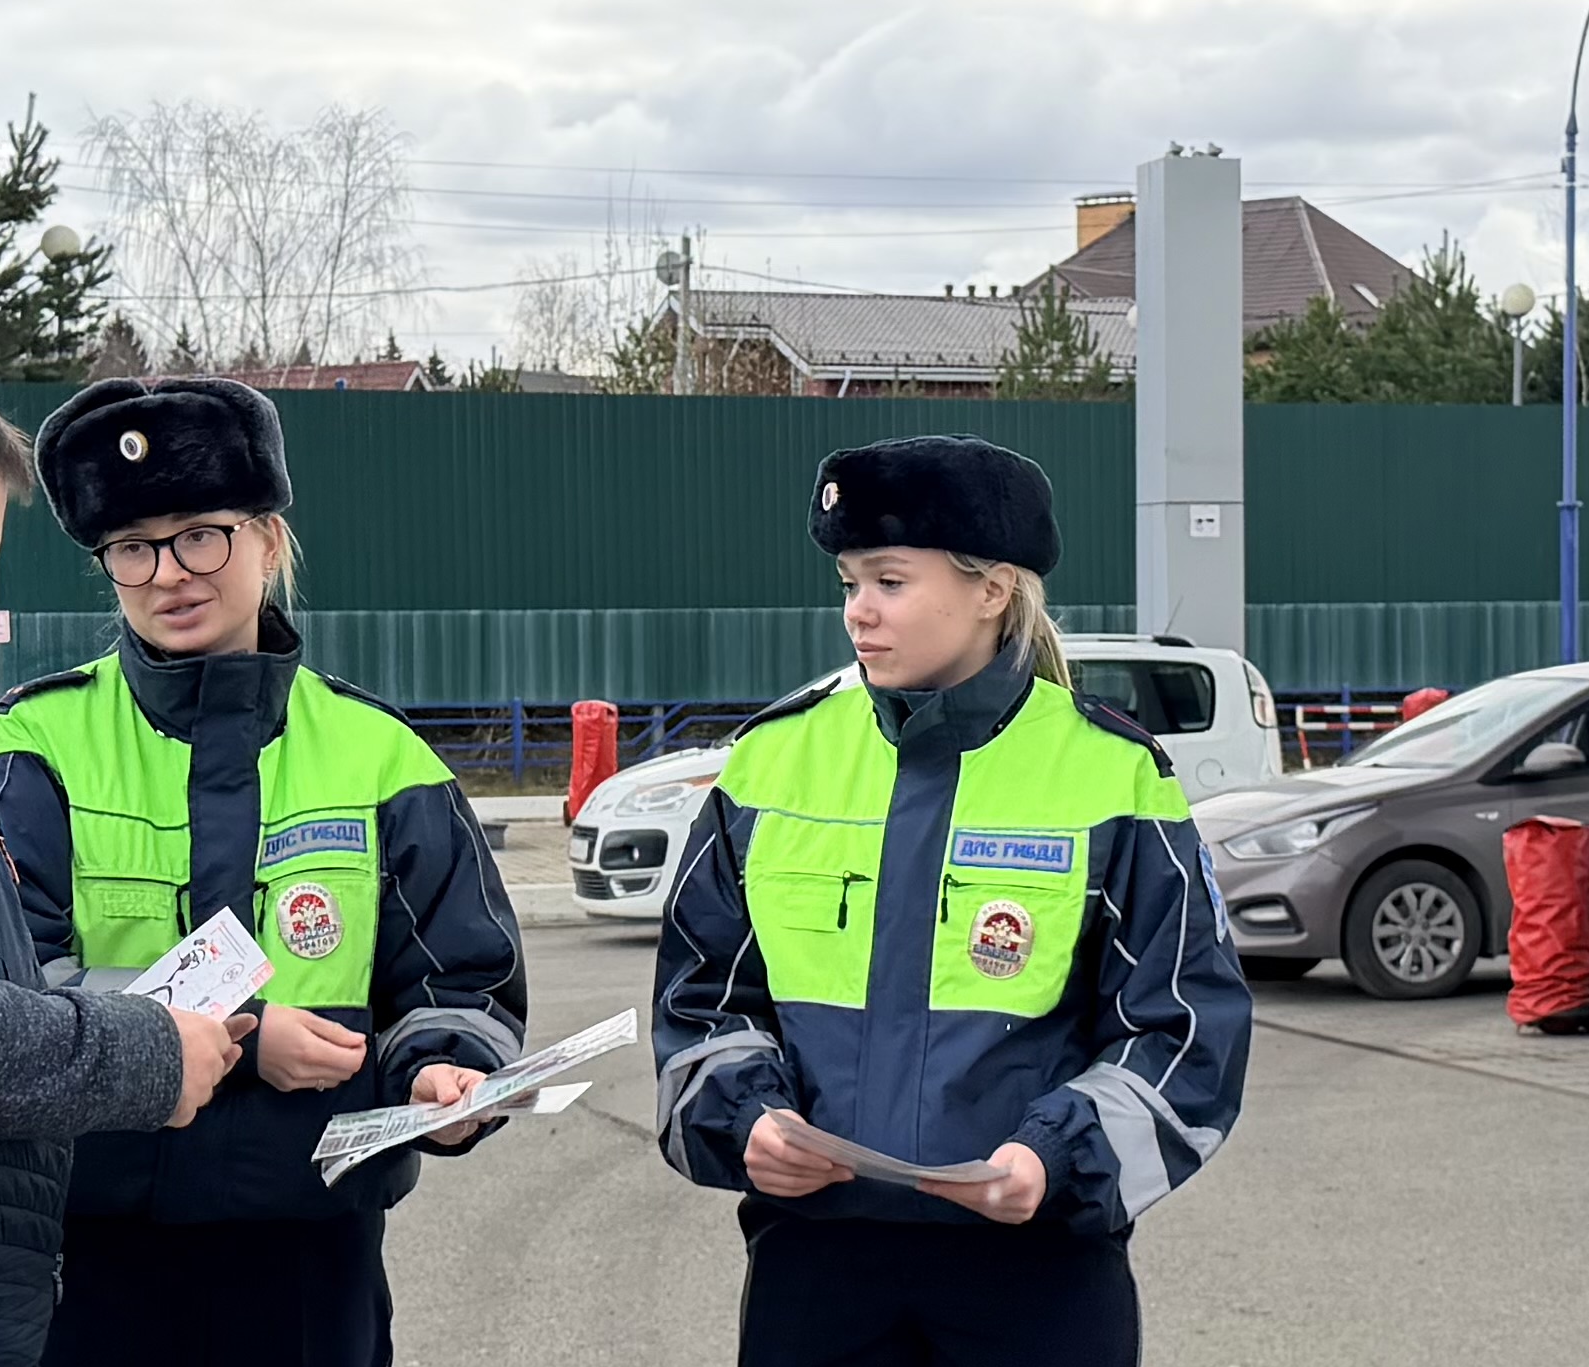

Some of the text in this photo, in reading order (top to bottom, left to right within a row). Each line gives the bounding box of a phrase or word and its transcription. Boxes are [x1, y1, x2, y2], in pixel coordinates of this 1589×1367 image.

[265, 825, 361, 857] ДПС ГИБДД
[960, 839, 1064, 863] ДПС ГИБДД
